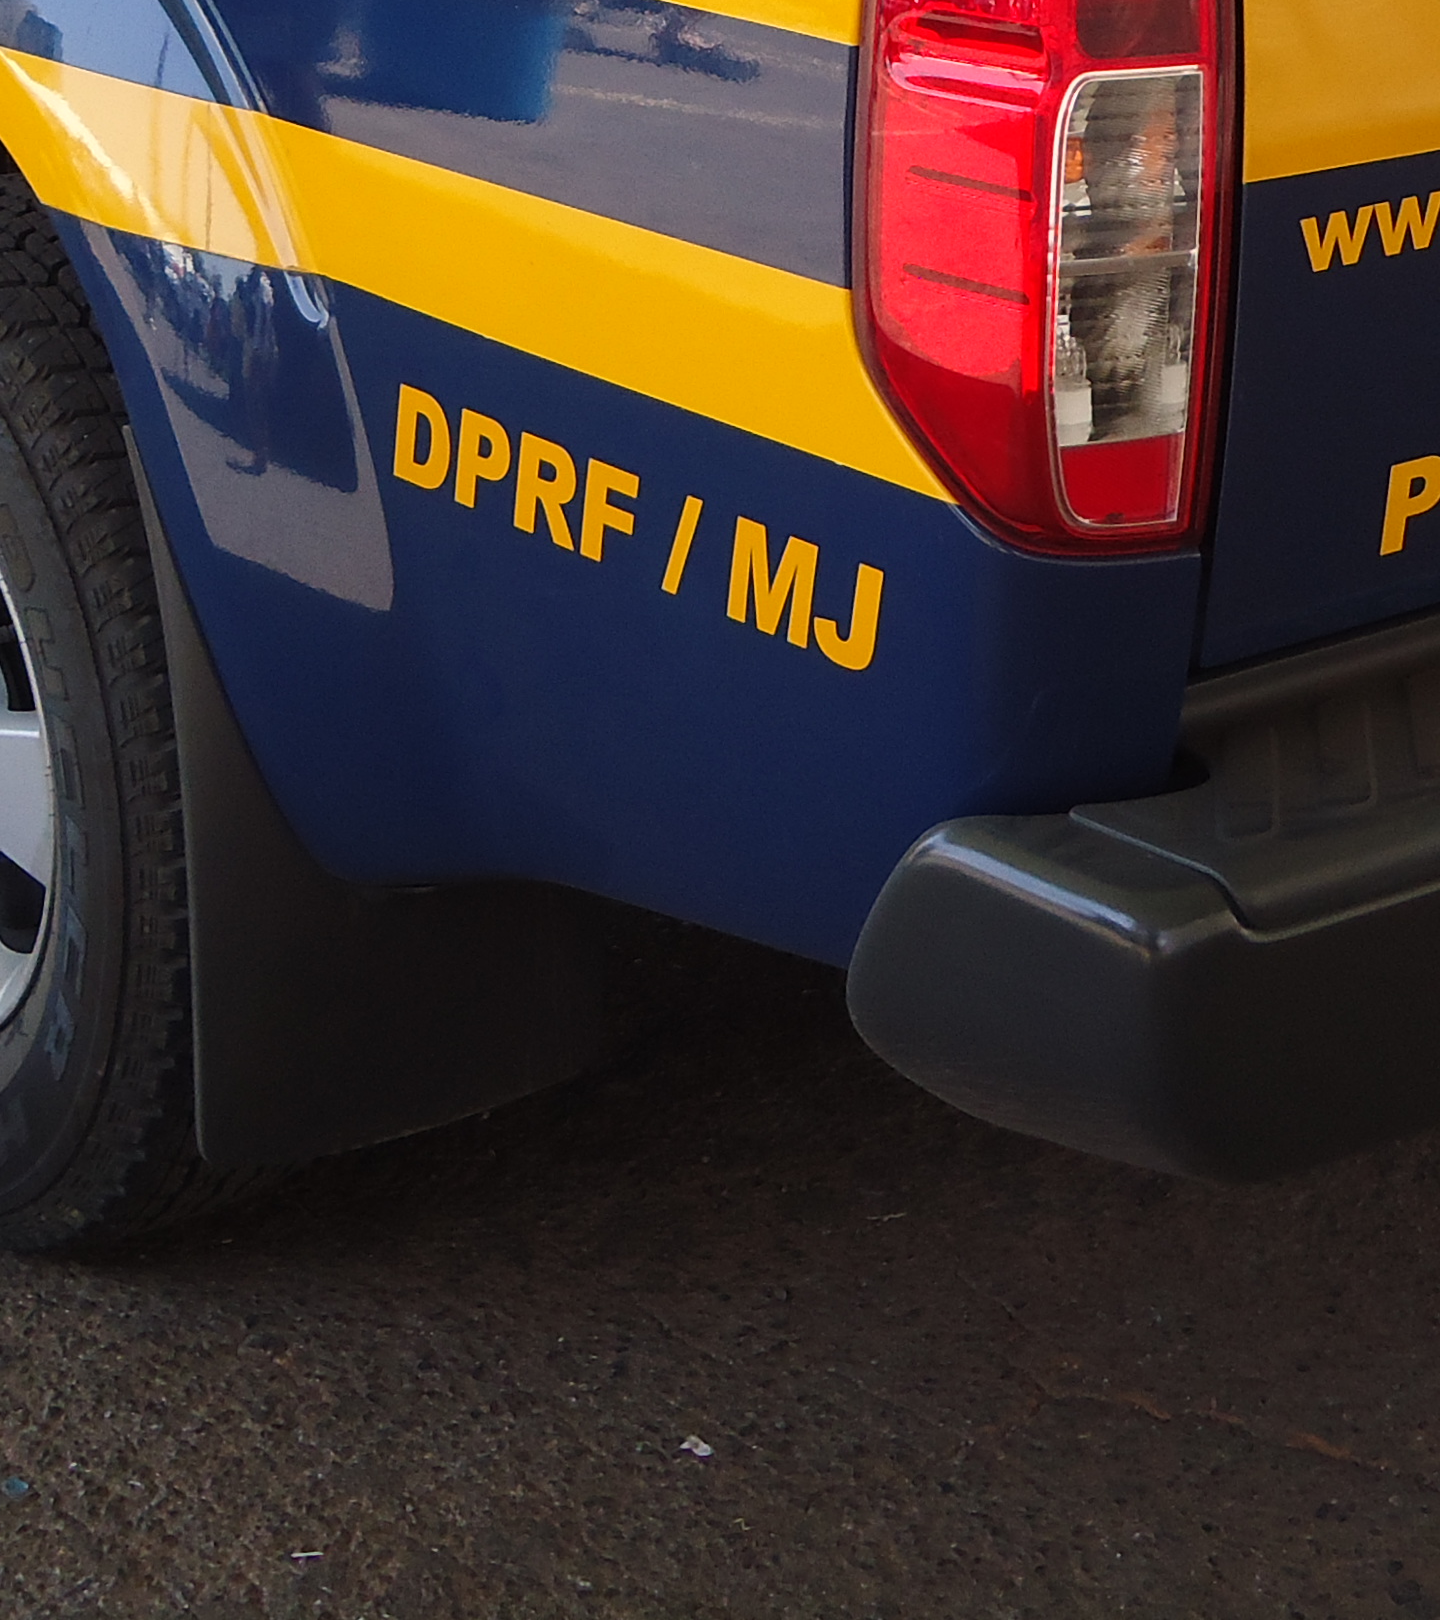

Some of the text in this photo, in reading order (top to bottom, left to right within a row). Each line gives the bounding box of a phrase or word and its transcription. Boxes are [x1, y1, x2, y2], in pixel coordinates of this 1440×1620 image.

[393, 382, 885, 671] DPRF / MJ
